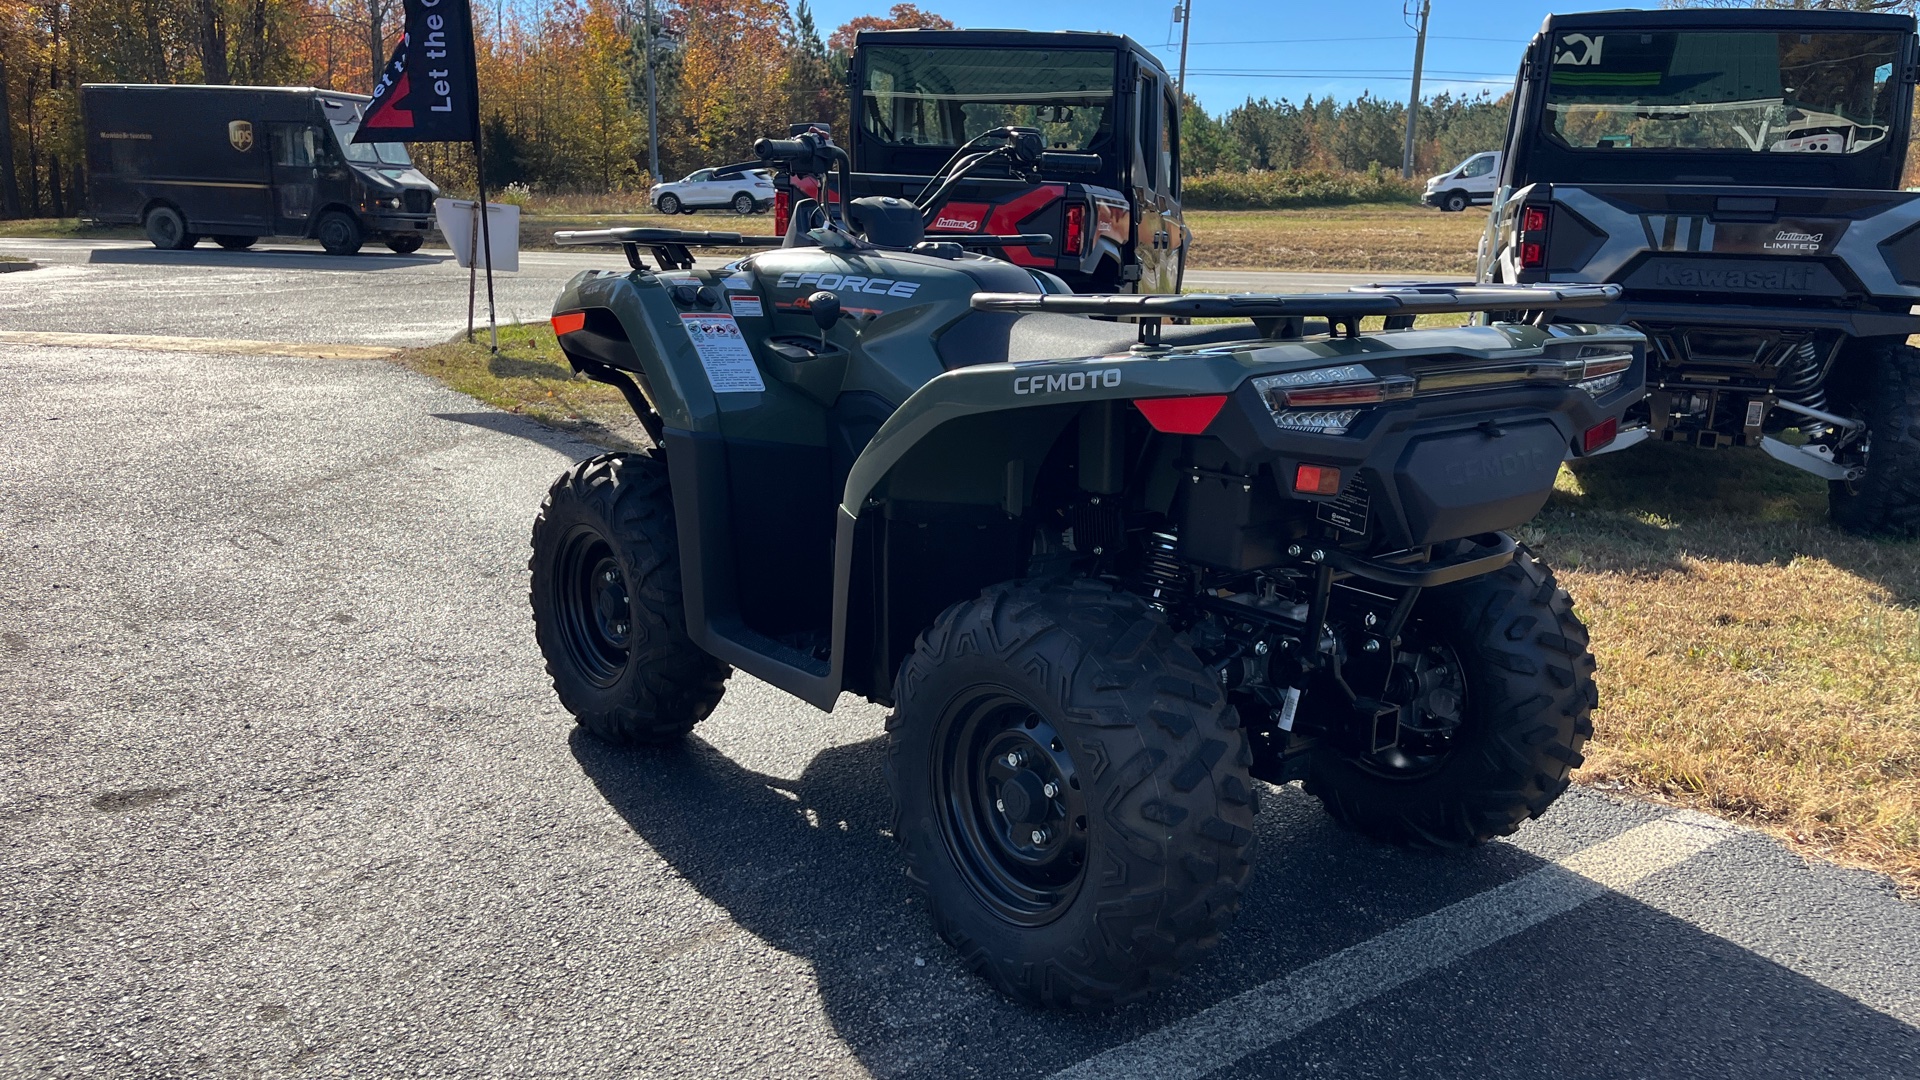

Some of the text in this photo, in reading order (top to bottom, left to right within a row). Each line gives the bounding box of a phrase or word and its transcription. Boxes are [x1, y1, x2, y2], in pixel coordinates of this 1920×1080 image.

[423, 14, 447, 59] the
[429, 69, 453, 112] Let
[231, 130, 252, 148] ups
[936, 218, 966, 228] Inline
[1763, 242, 1820, 250] LIMITED
[1776, 231, 1810, 241] Inline
[1656, 263, 1815, 291] Kawasaki
[1014, 368, 1122, 395] CFMOTO
